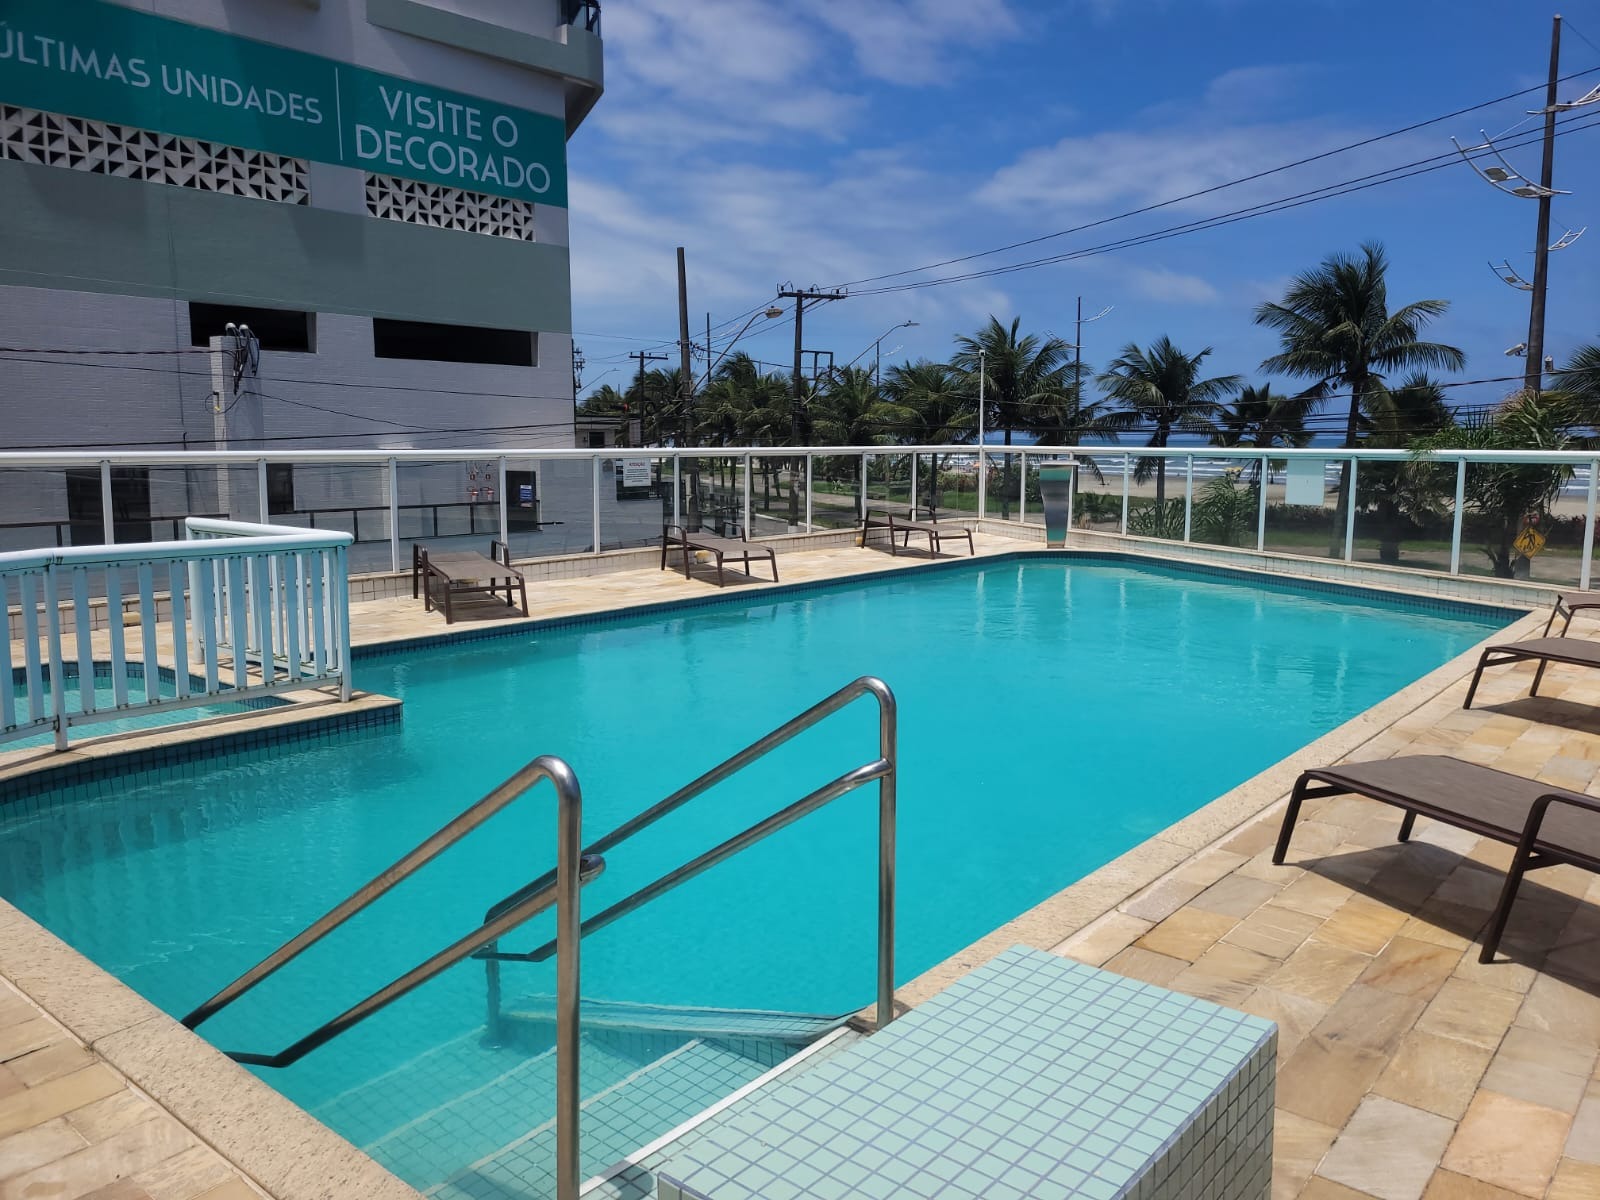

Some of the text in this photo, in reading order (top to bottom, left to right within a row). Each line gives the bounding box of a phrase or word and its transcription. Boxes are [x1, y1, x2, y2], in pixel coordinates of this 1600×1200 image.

[161, 64, 323, 124] UNIDADES
[379, 85, 519, 148] VISITE O
[355, 123, 551, 193] DECORADO
